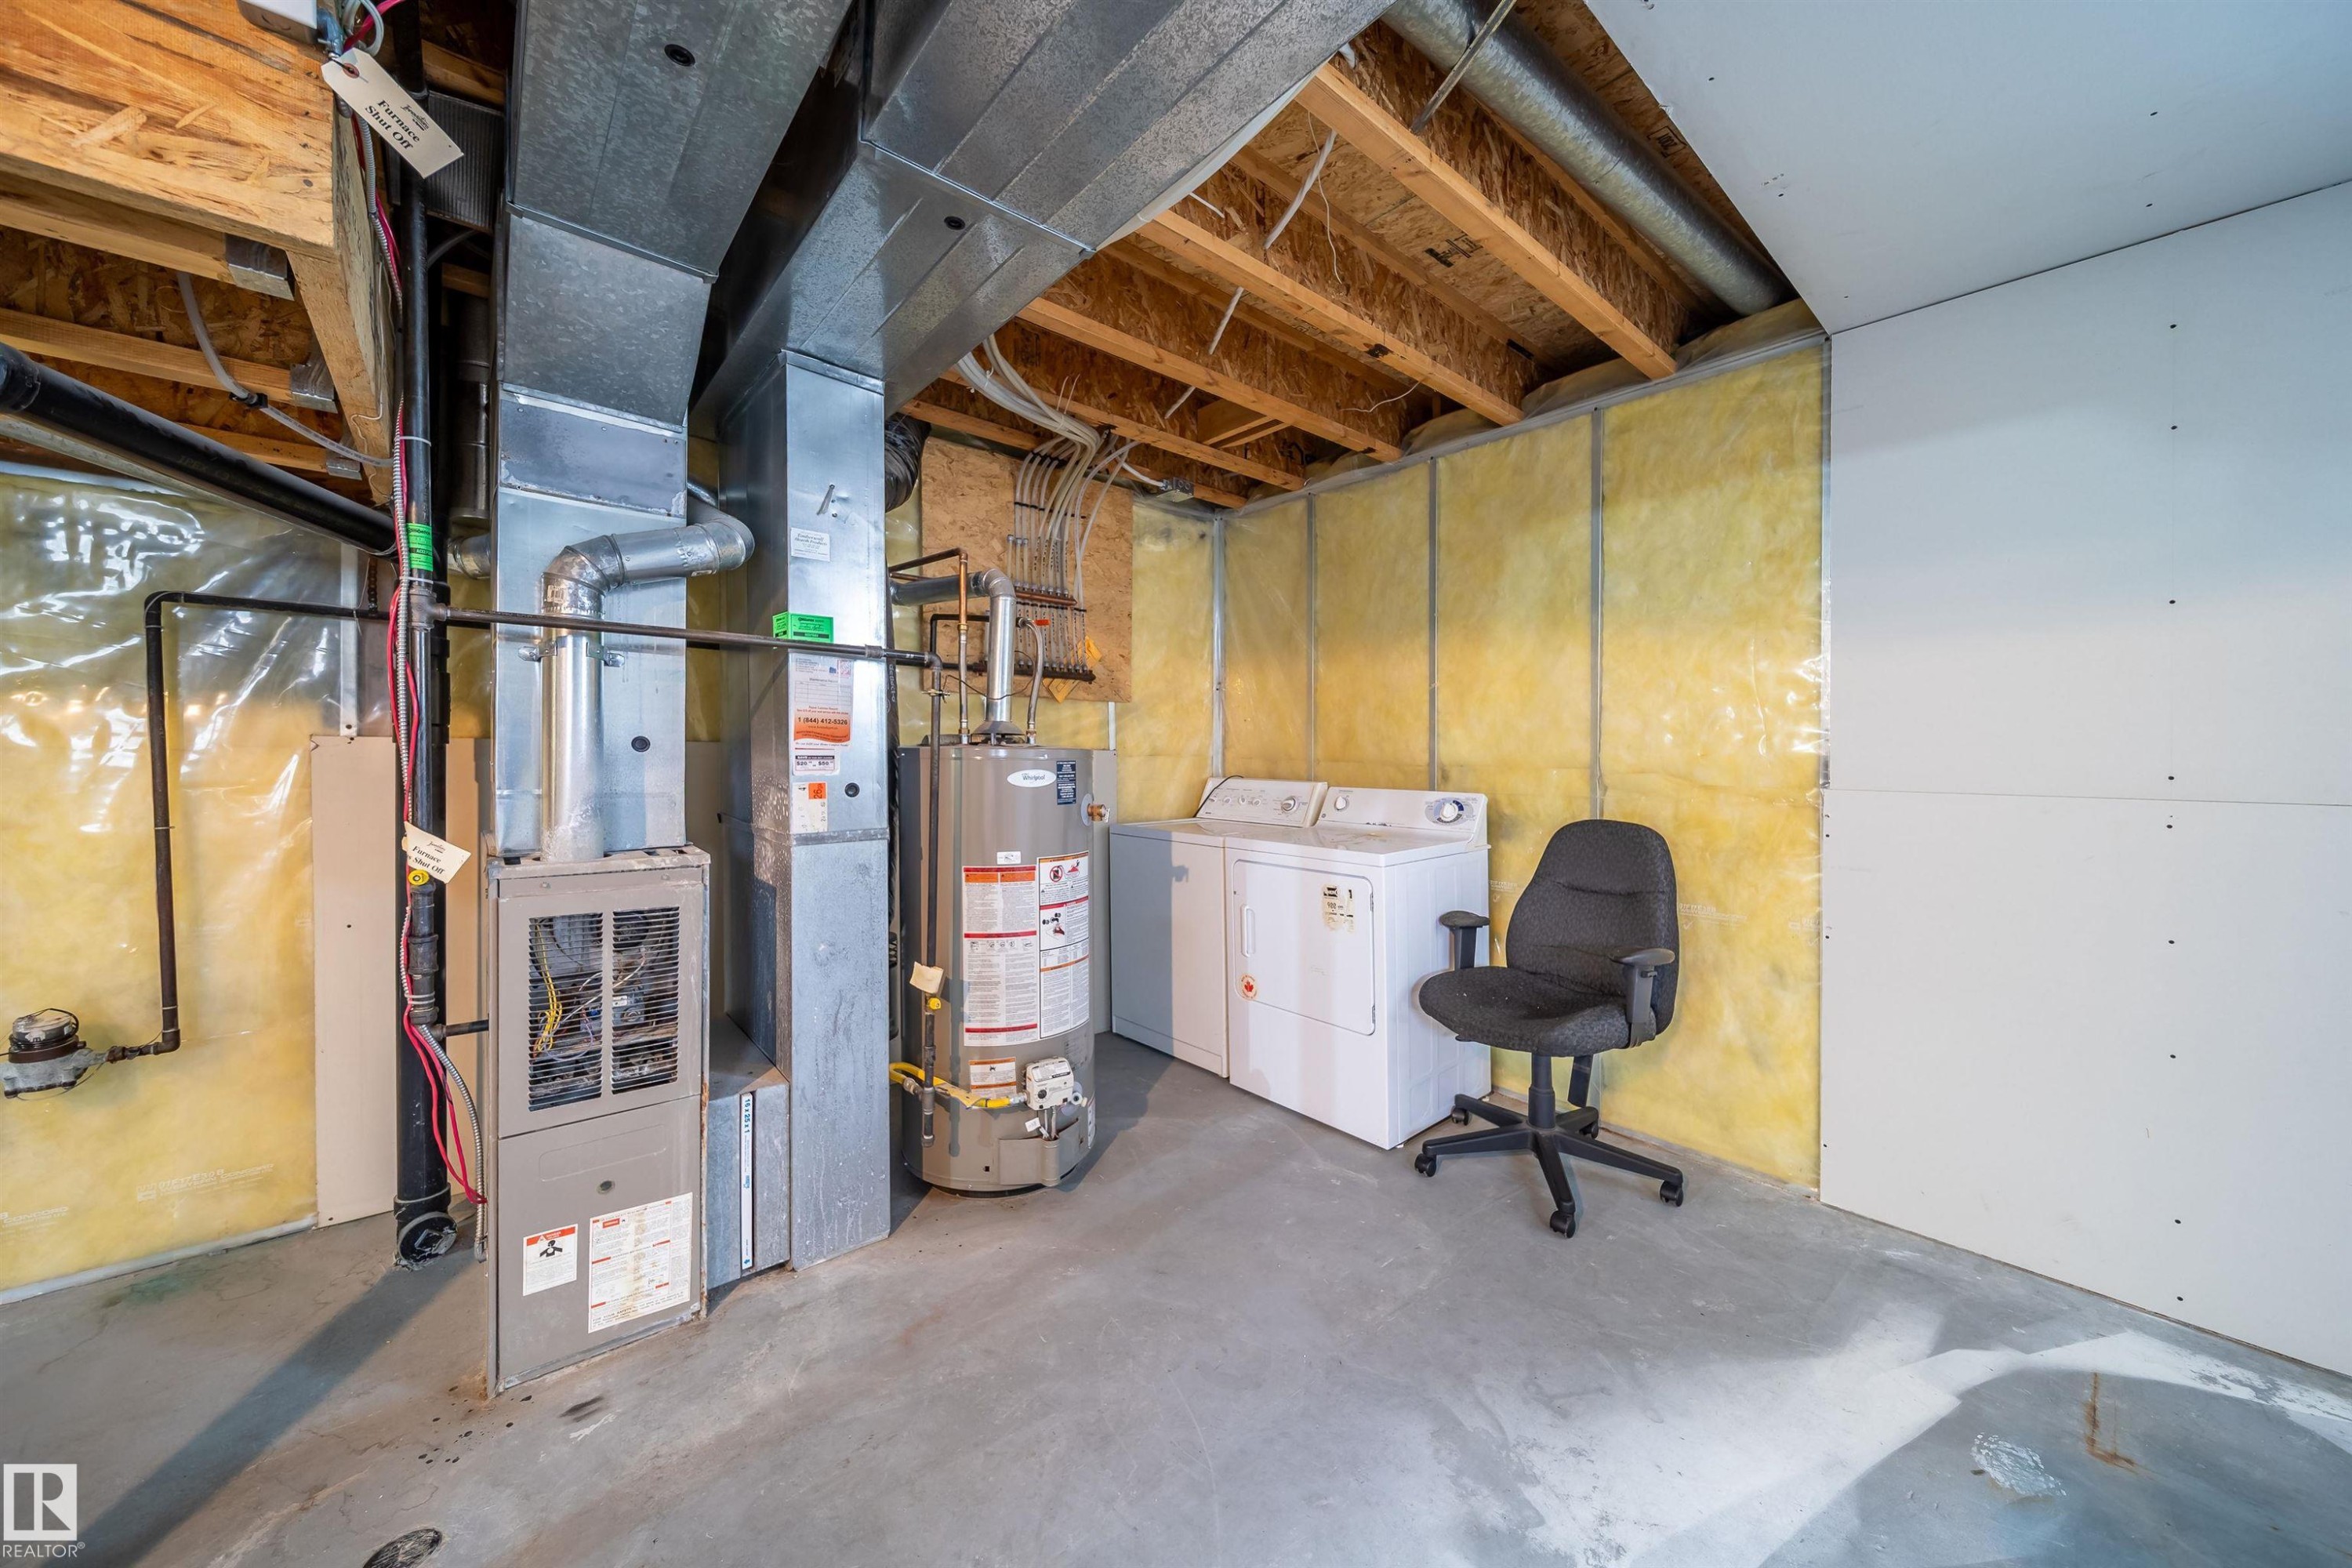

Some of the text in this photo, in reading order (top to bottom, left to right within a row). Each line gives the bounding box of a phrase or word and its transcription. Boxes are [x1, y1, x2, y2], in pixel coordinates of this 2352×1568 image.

[365, 105, 392, 131] Shut
[392, 131, 413, 151] Off
[378, 100, 420, 143] Furnace
[412, 845, 441, 863] Furnace
[413, 856, 430, 869] Shut
[431, 865, 446, 875] Off
[745, 1098, 751, 1108] 16
[744, 1113, 751, 1123] 25
